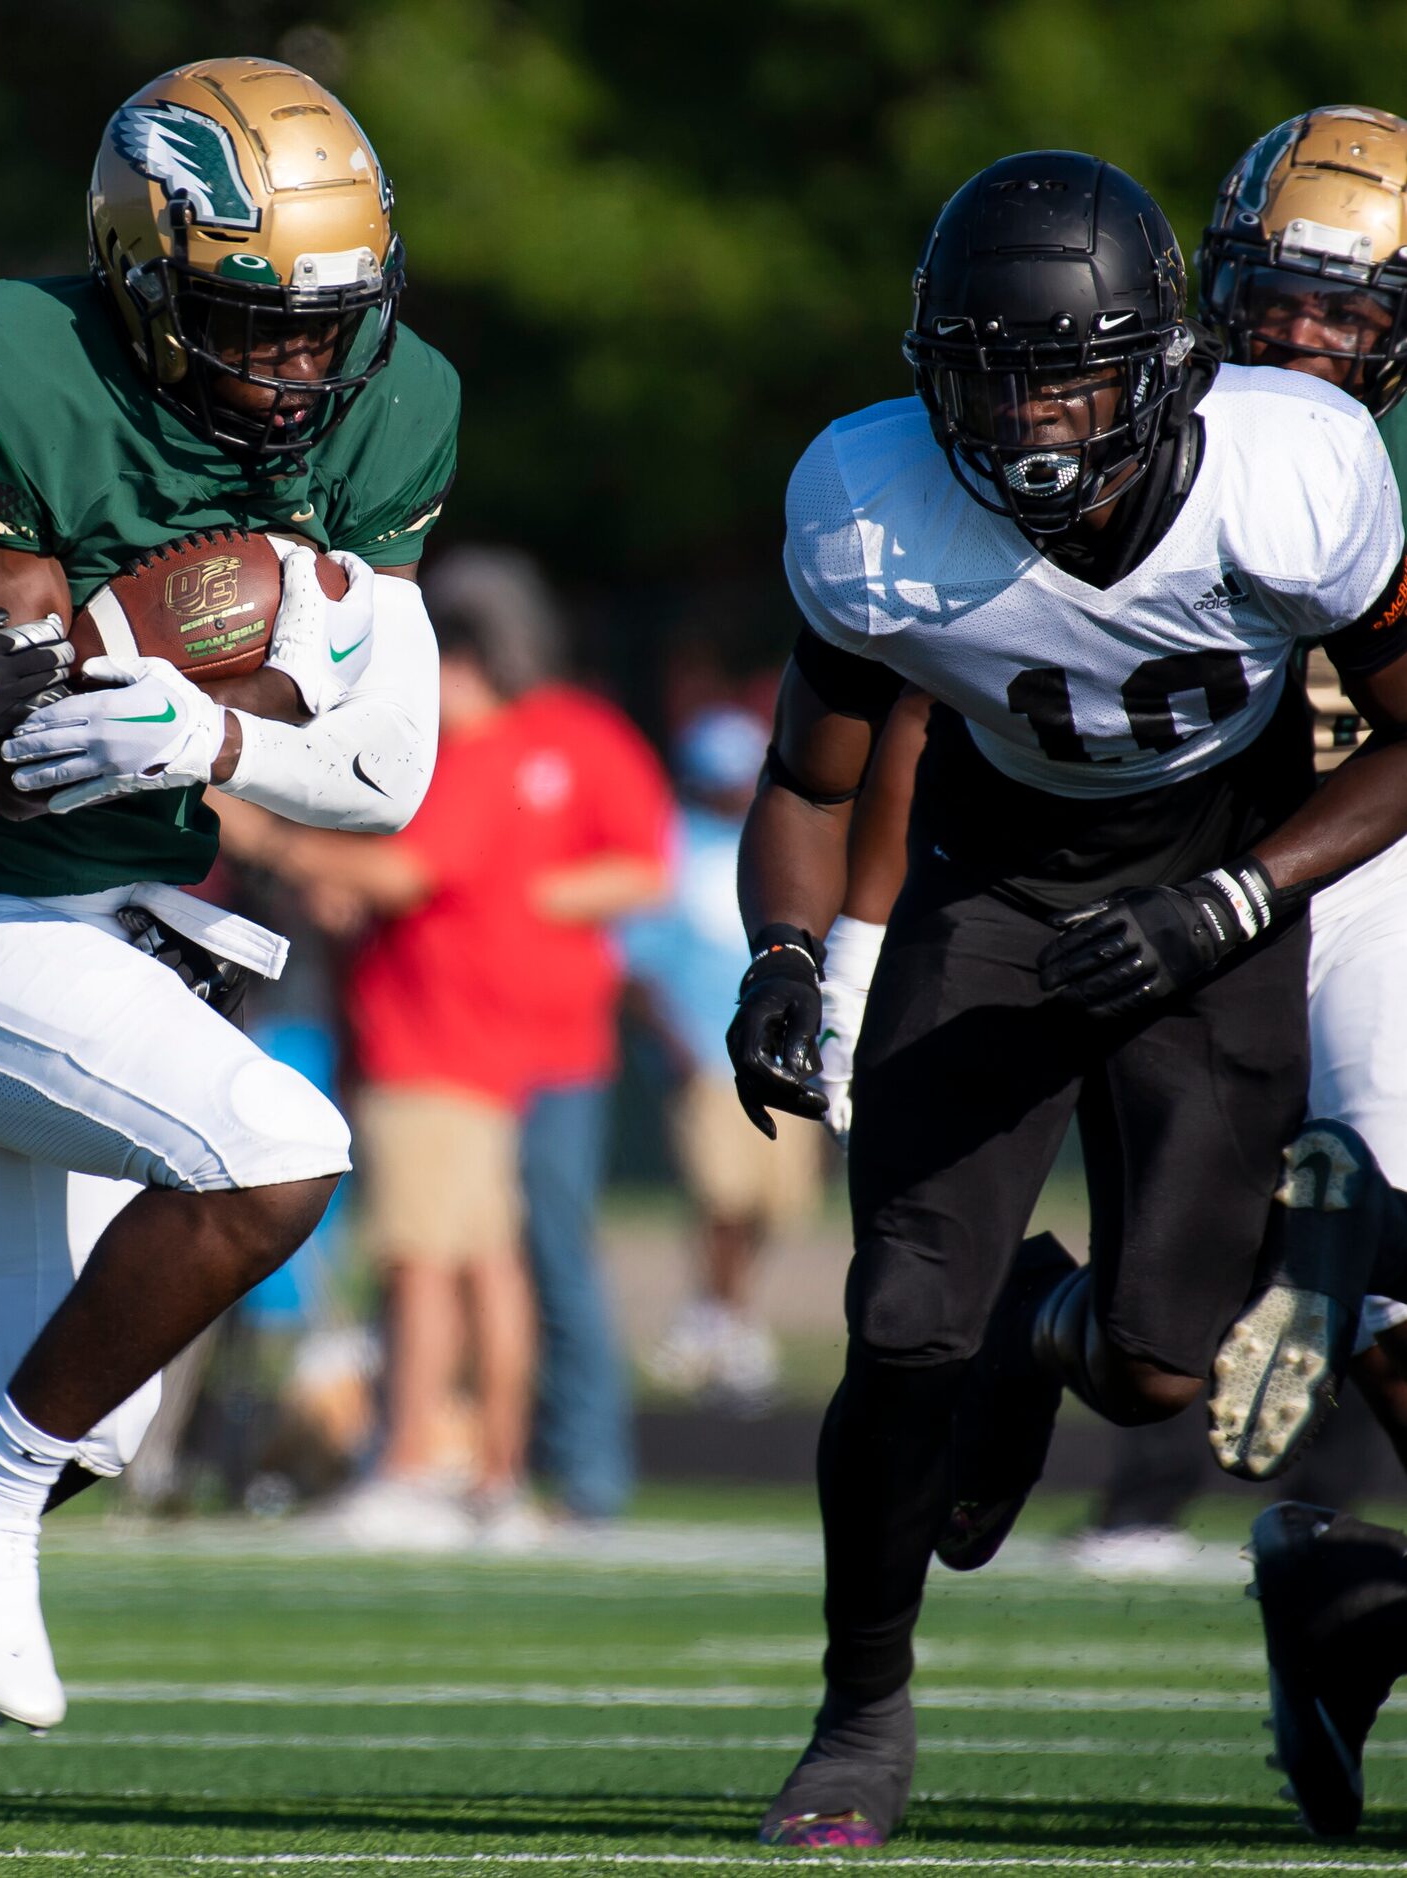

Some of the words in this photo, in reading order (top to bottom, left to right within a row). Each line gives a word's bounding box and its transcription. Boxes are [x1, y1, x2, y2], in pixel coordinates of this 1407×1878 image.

[1193, 592, 1250, 611] adidas
[185, 634, 226, 653] TEAM
[227, 619, 266, 642] ISSUE
